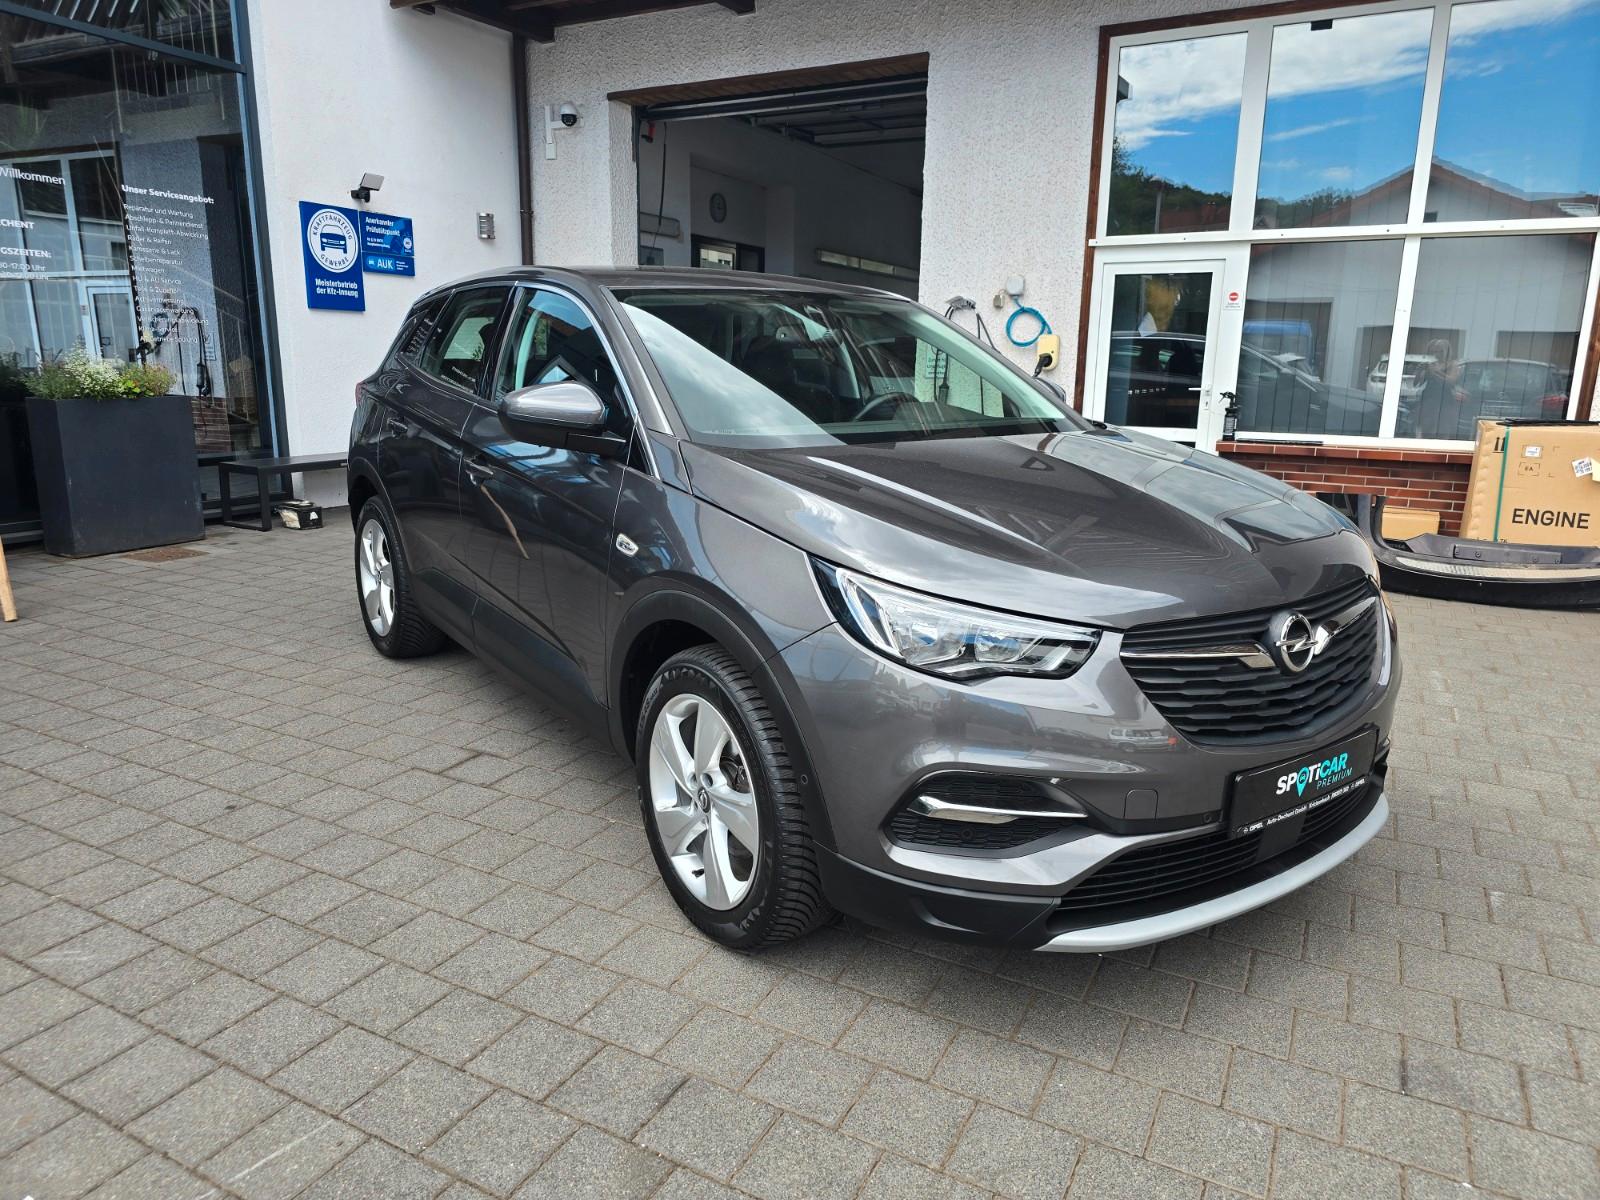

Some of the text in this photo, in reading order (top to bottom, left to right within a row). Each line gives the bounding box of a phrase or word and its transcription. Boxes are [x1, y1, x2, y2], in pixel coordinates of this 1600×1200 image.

[0, 166, 66, 185] Willkommen
[121, 184, 214, 204] Unser Serviceangebot:
[167, 209, 194, 219] Wartung
[0, 219, 35, 230] CHENT
[313, 212, 352, 240] KRAFTFAHRZEUG
[320, 254, 349, 267] GEWERBE
[377, 258, 394, 270] AUK
[315, 278, 358, 290] Meisterbetrieb
[316, 286, 359, 299] der Kfz-Innung
[1511, 508, 1591, 529] ENGINE
[1316, 767, 1353, 790] PREMIUM
